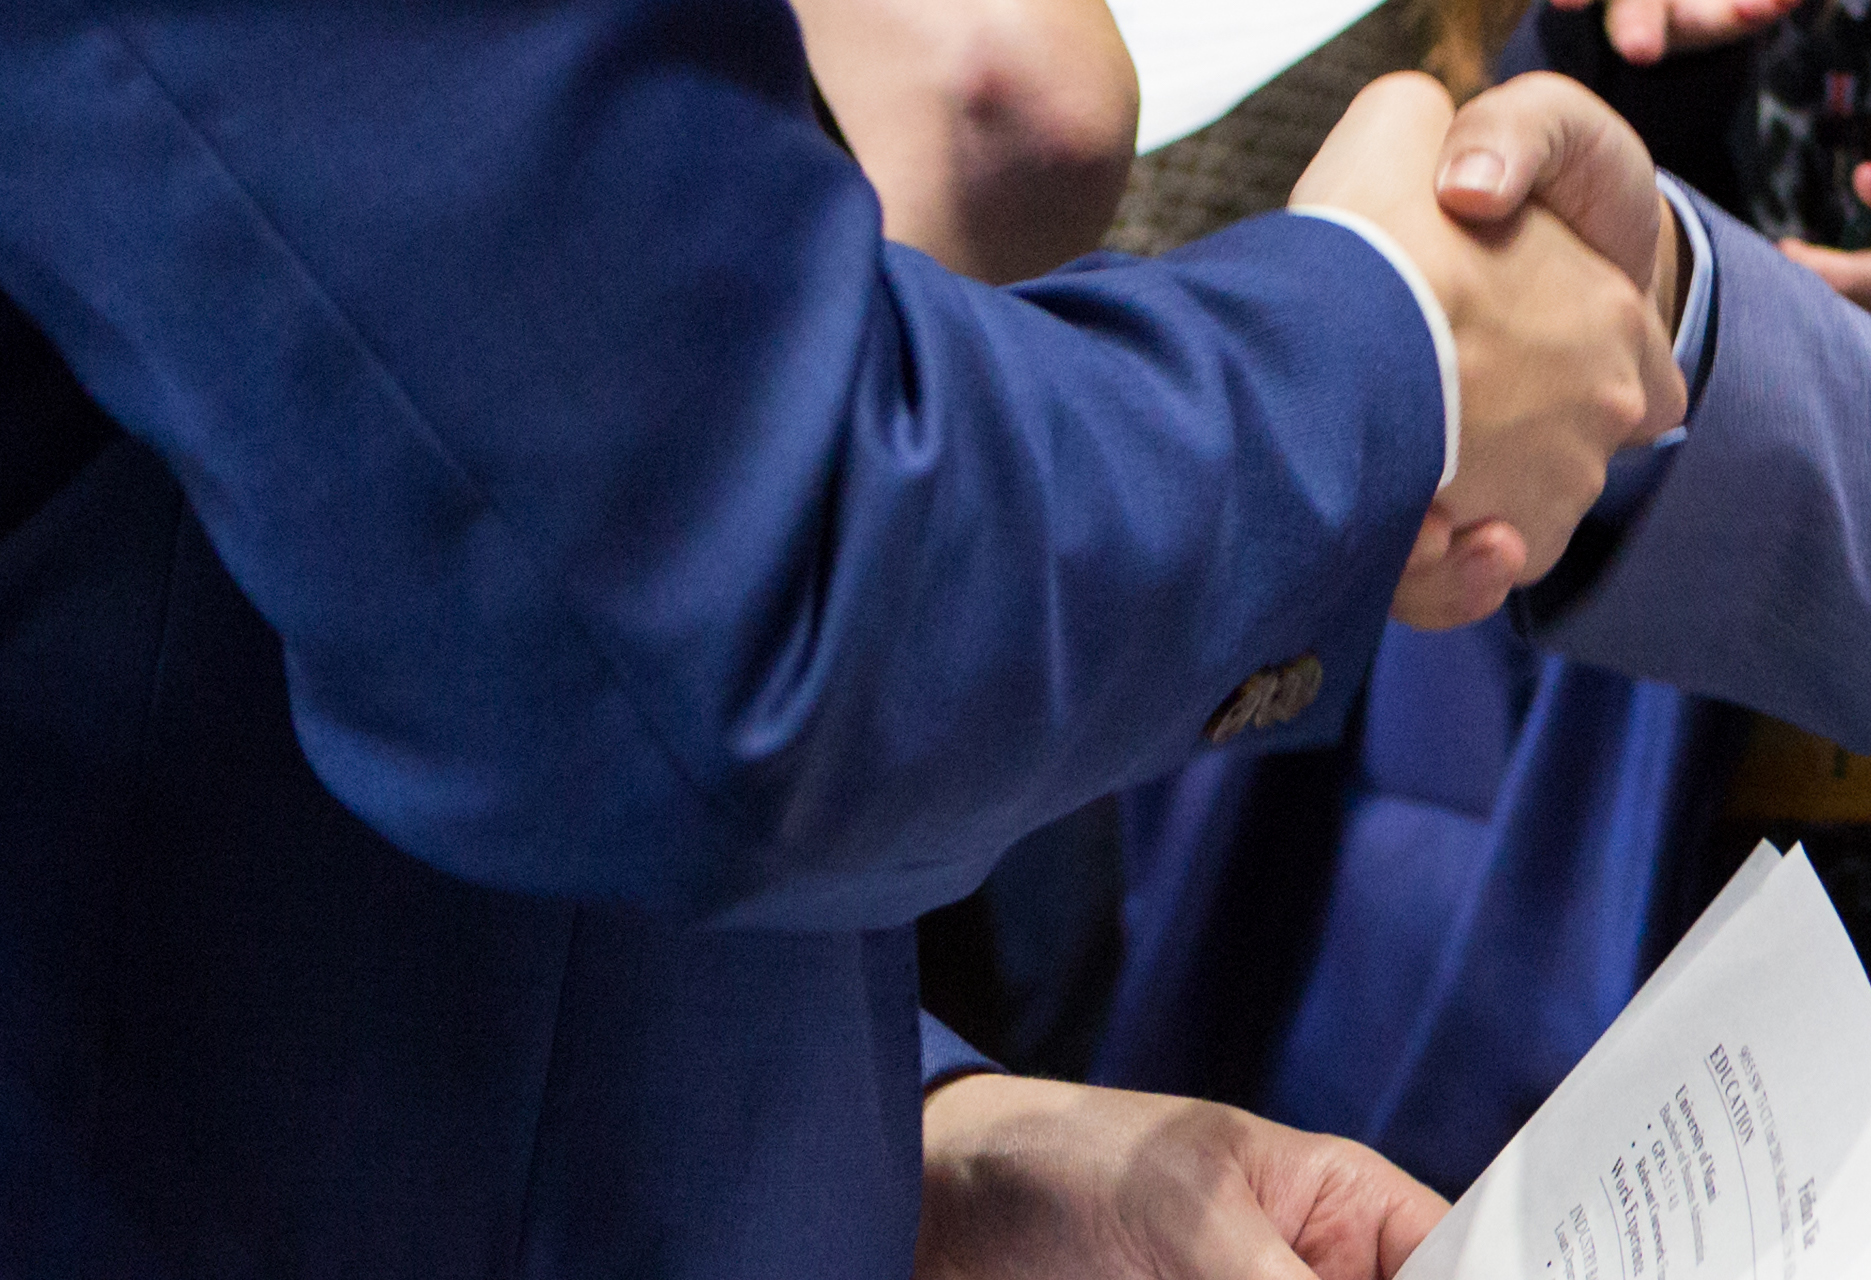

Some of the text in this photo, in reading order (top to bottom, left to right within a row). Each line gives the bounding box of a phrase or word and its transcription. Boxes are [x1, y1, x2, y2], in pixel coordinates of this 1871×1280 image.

[1675, 1083, 1704, 1154] University
[1709, 1043, 1754, 1146] EDUCATION
[1611, 1156, 1635, 1208] Work
